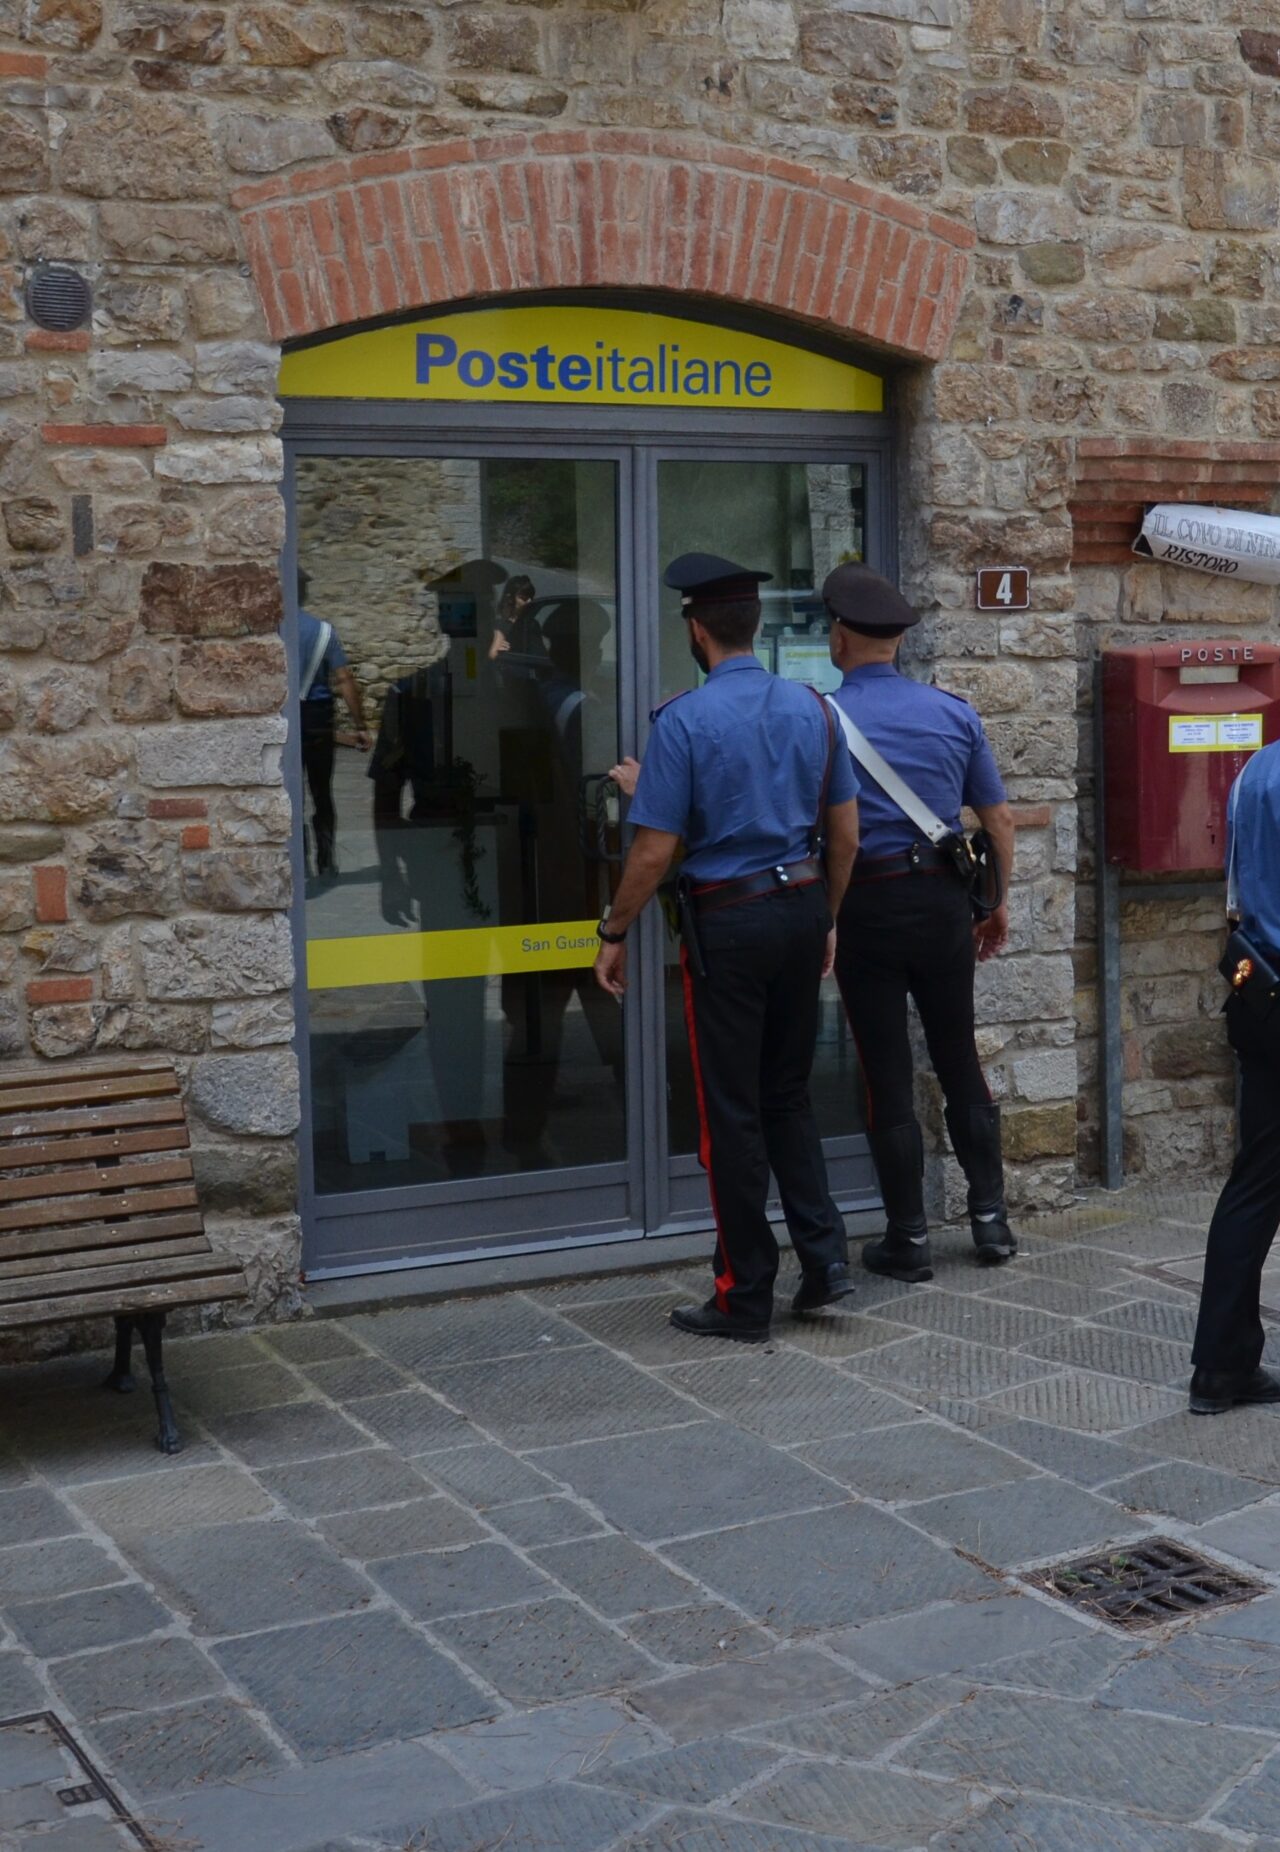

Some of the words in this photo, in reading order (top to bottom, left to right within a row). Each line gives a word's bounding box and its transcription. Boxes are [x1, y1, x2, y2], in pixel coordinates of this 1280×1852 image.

[415, 332, 772, 397] Posteitaliane
[1152, 513, 1174, 538] IL
[1177, 518, 1222, 547] COVO
[1224, 527, 1244, 552] DI
[1160, 543, 1240, 574] RISTORO
[995, 572, 1013, 605] 4
[1180, 646, 1255, 662] POSTE
[521, 938, 551, 953] San
[555, 935, 600, 951] Gusm
